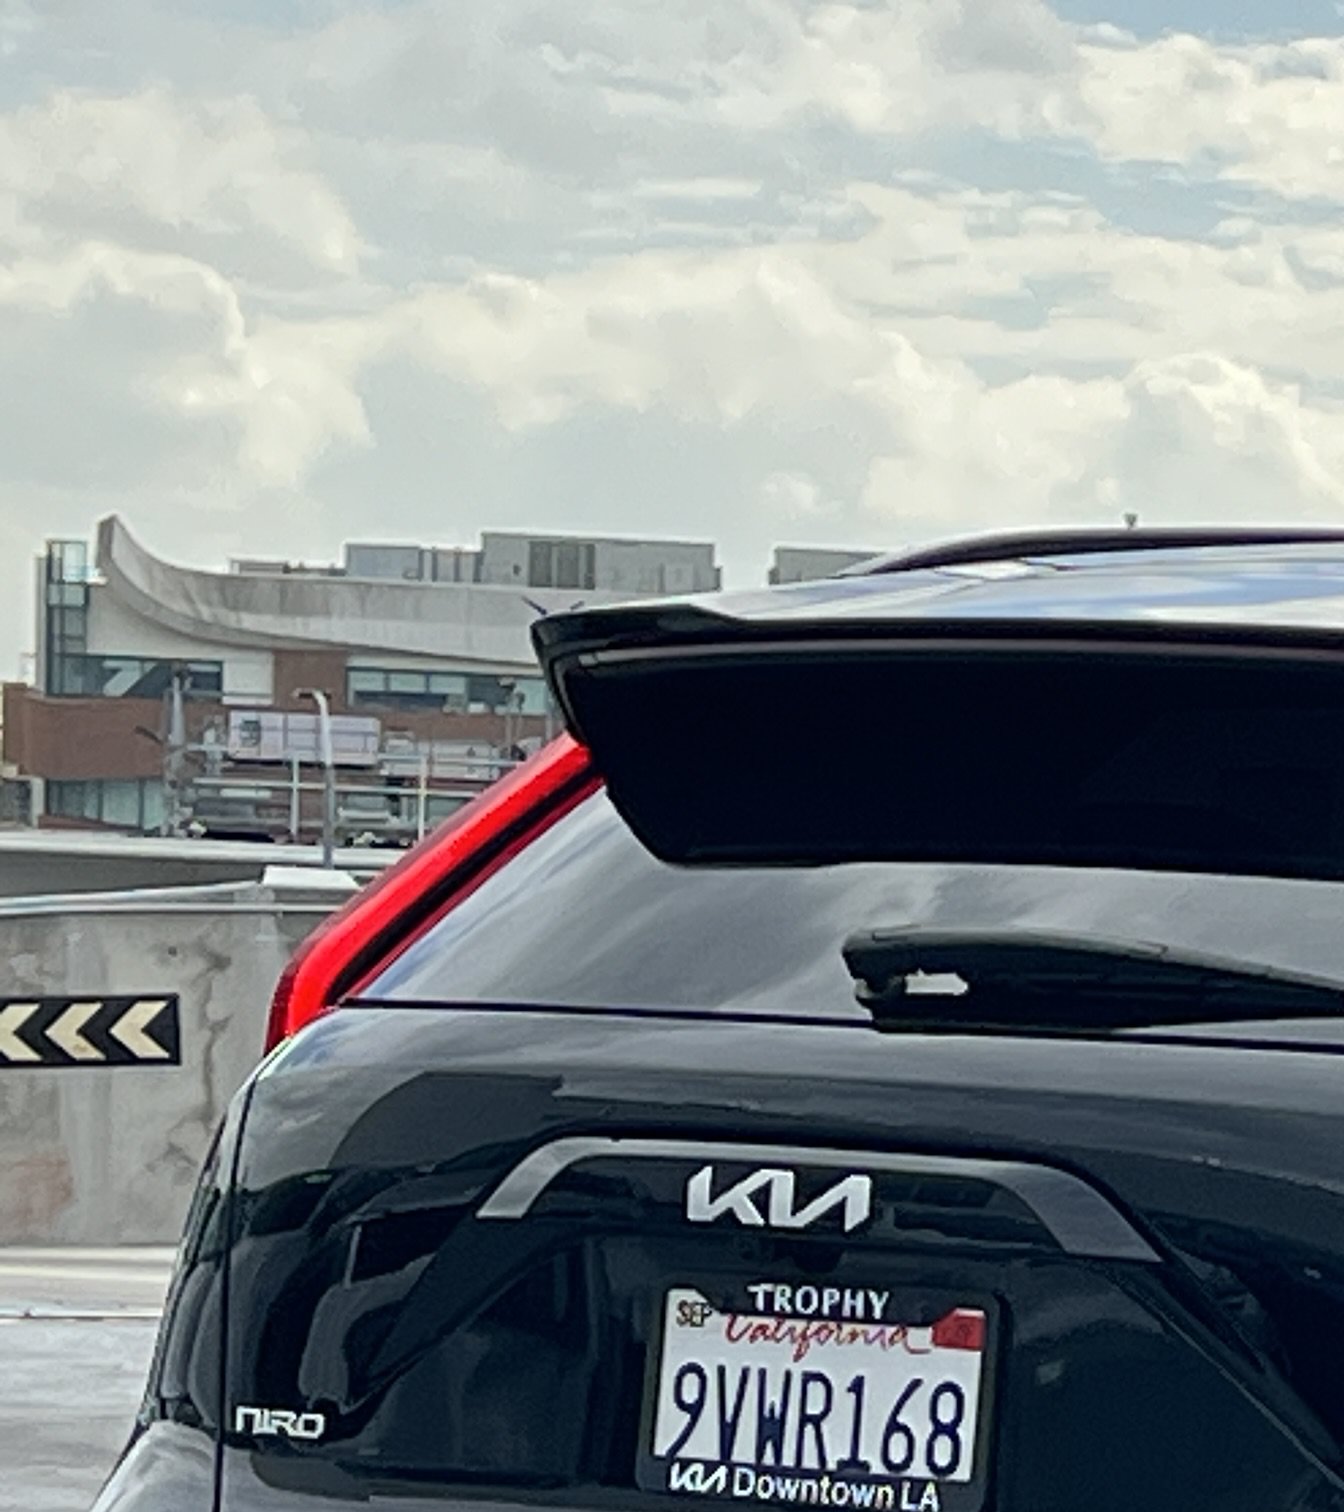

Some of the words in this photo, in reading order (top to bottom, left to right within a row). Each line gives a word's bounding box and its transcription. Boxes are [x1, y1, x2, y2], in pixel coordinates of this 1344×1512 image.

[687, 1165, 873, 1233] KIA
[676, 1300, 712, 1327] SEP
[747, 1283, 890, 1320] TROPHY
[724, 1312, 932, 1362] California
[236, 1405, 325, 1439] NIRO
[666, 1361, 965, 1478] 9VWR168
[669, 1462, 728, 1493] KIA
[732, 1466, 895, 1511] Downtown
